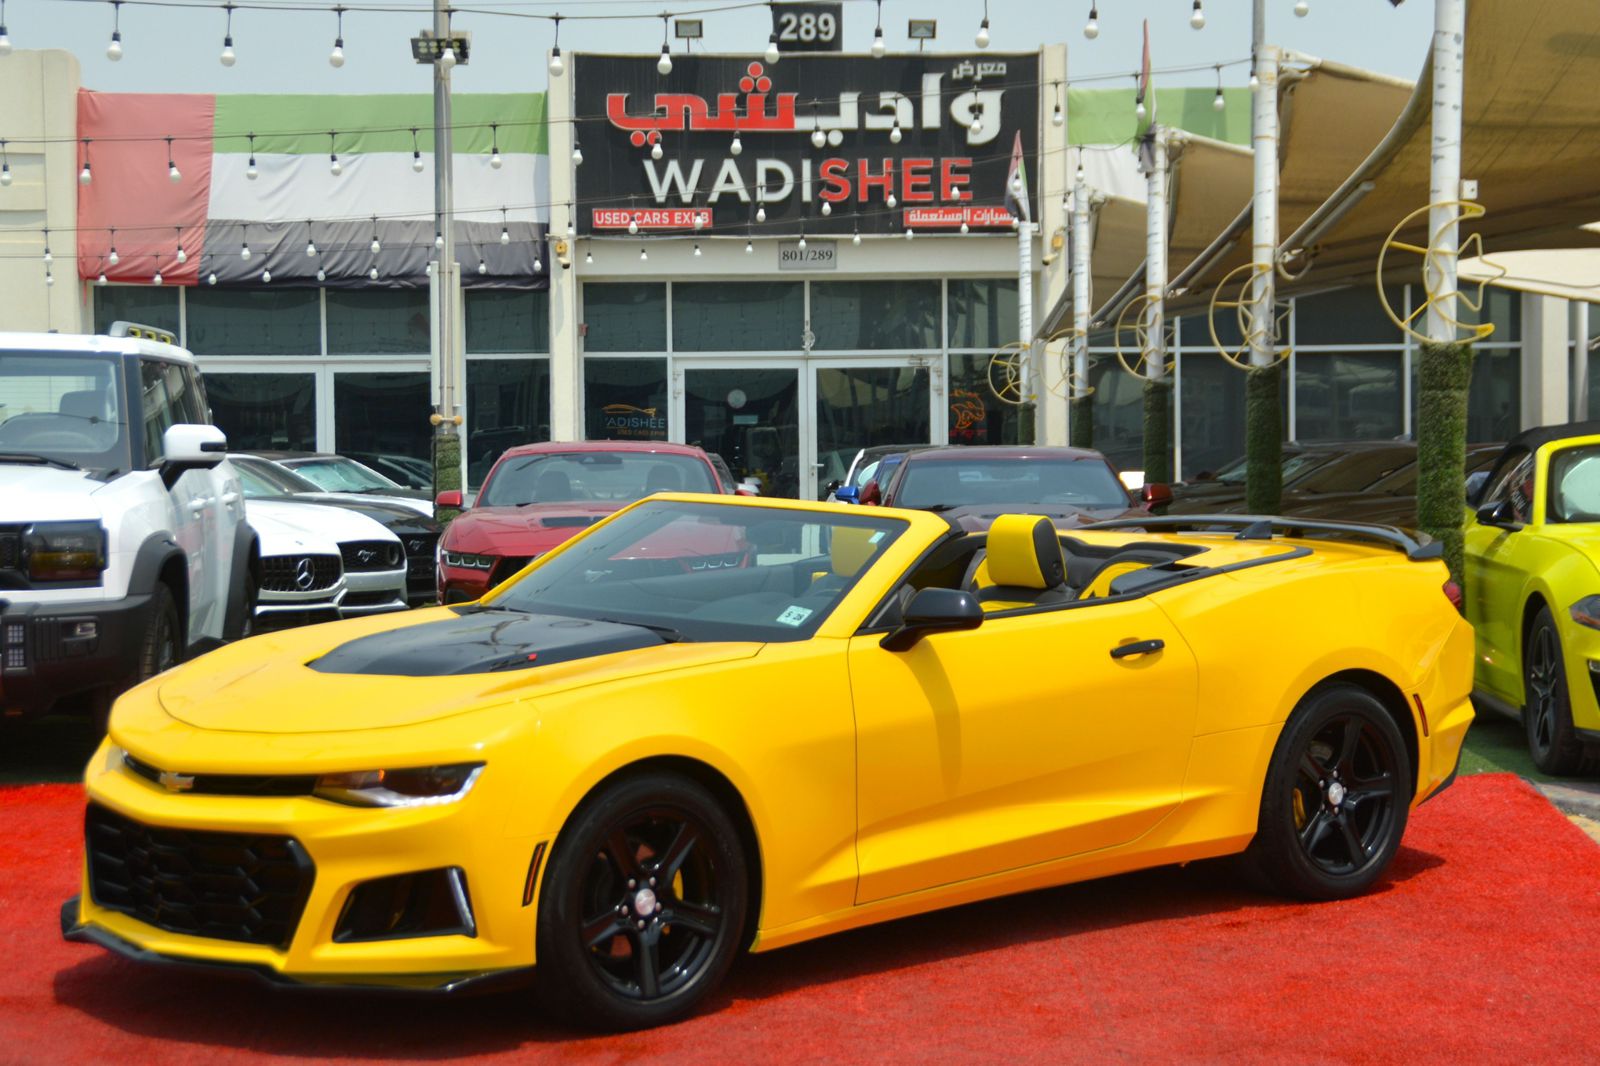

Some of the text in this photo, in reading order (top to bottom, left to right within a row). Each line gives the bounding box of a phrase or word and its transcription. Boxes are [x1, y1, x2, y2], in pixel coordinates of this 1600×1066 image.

[780, 12, 836, 41] 289
[952, 60, 1007, 80] معرض
[642, 157, 973, 203] WADISHEE
[595, 212, 629, 224] USED
[634, 212, 669, 224] CARS
[909, 208, 971, 223] المستعملة
[782, 250, 833, 261] 801/289
[605, 417, 665, 428] ADISHEE
